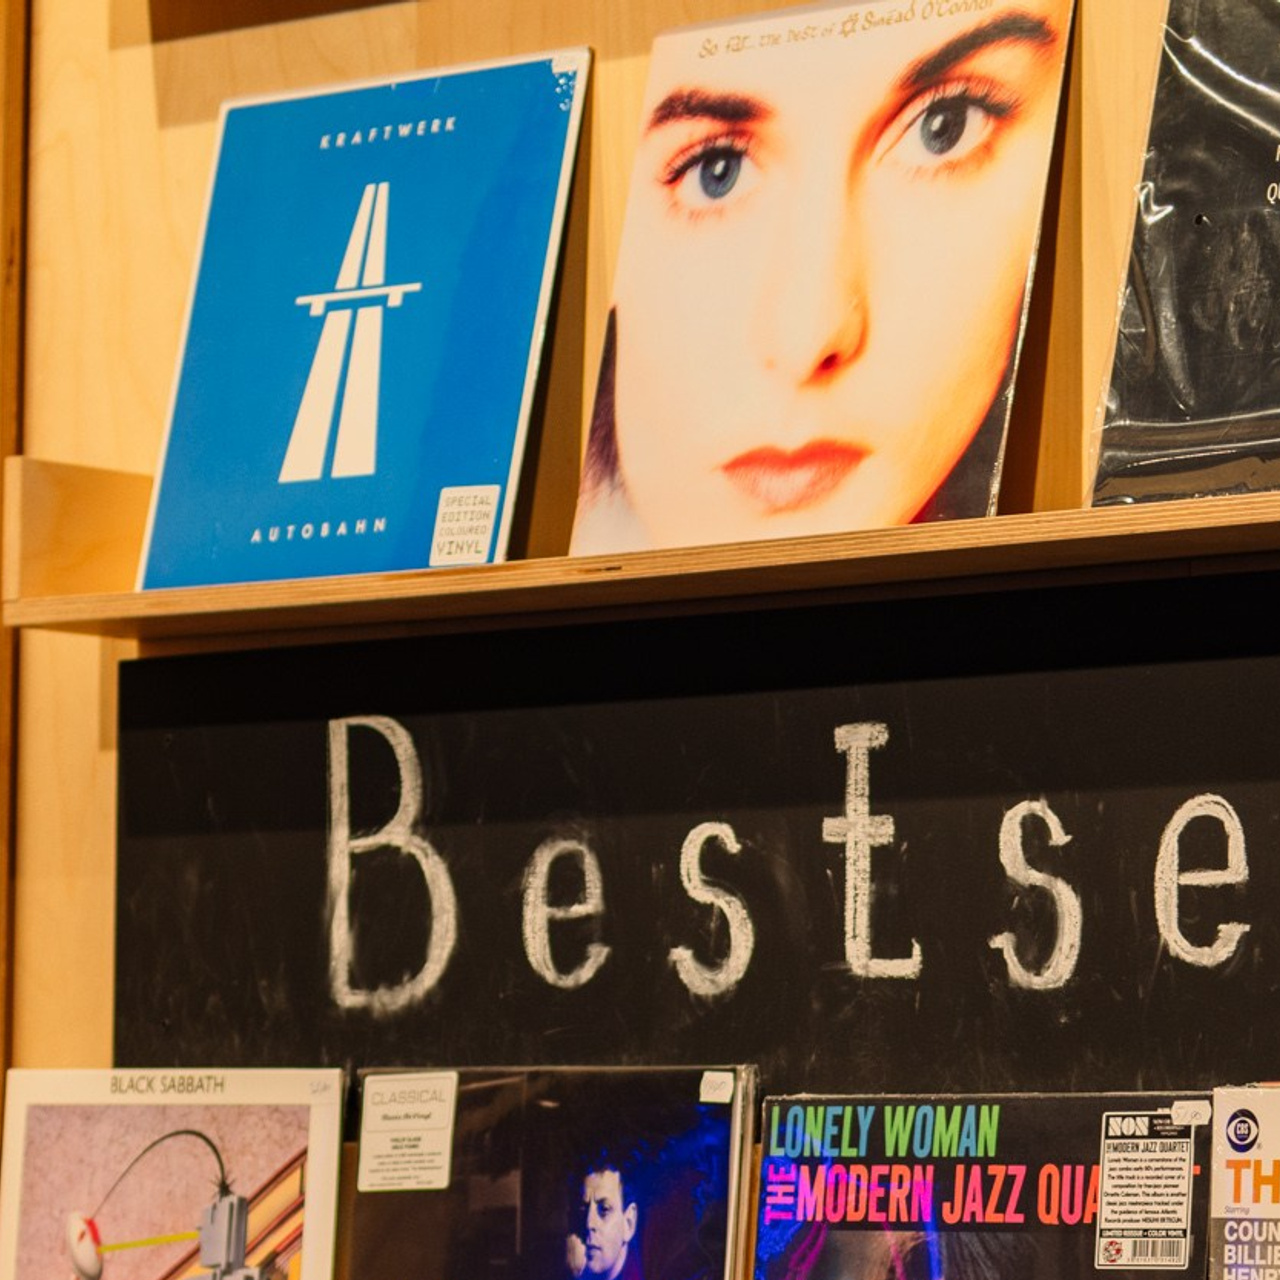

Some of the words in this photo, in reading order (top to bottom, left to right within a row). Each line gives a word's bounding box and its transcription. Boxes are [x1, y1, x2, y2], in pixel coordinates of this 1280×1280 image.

[319, 116, 456, 149] KRAFTWERK
[444, 495, 491, 507] SPECIAL
[440, 510, 490, 523] EDITION
[250, 517, 387, 544] AUTOBAHN
[438, 525, 488, 537] COLOURED
[436, 541, 484, 556] VINYL
[111, 1076, 155, 1094] BLACK
[160, 1075, 225, 1094] SABBATH
[371, 1089, 446, 1106] CLASSICAL
[770, 1105, 874, 1158] LONELY
[884, 1104, 1000, 1158] WOMAN
[1108, 1117, 1149, 1136] NON
[1113, 1142, 1140, 1153] MODERN
[1142, 1142, 1158, 1153] JAZZ
[1160, 1141, 1189, 1153] QUARTET
[764, 1163, 797, 1225] THE
[799, 1164, 934, 1224] MODERN
[942, 1164, 1027, 1225] JAZZ
